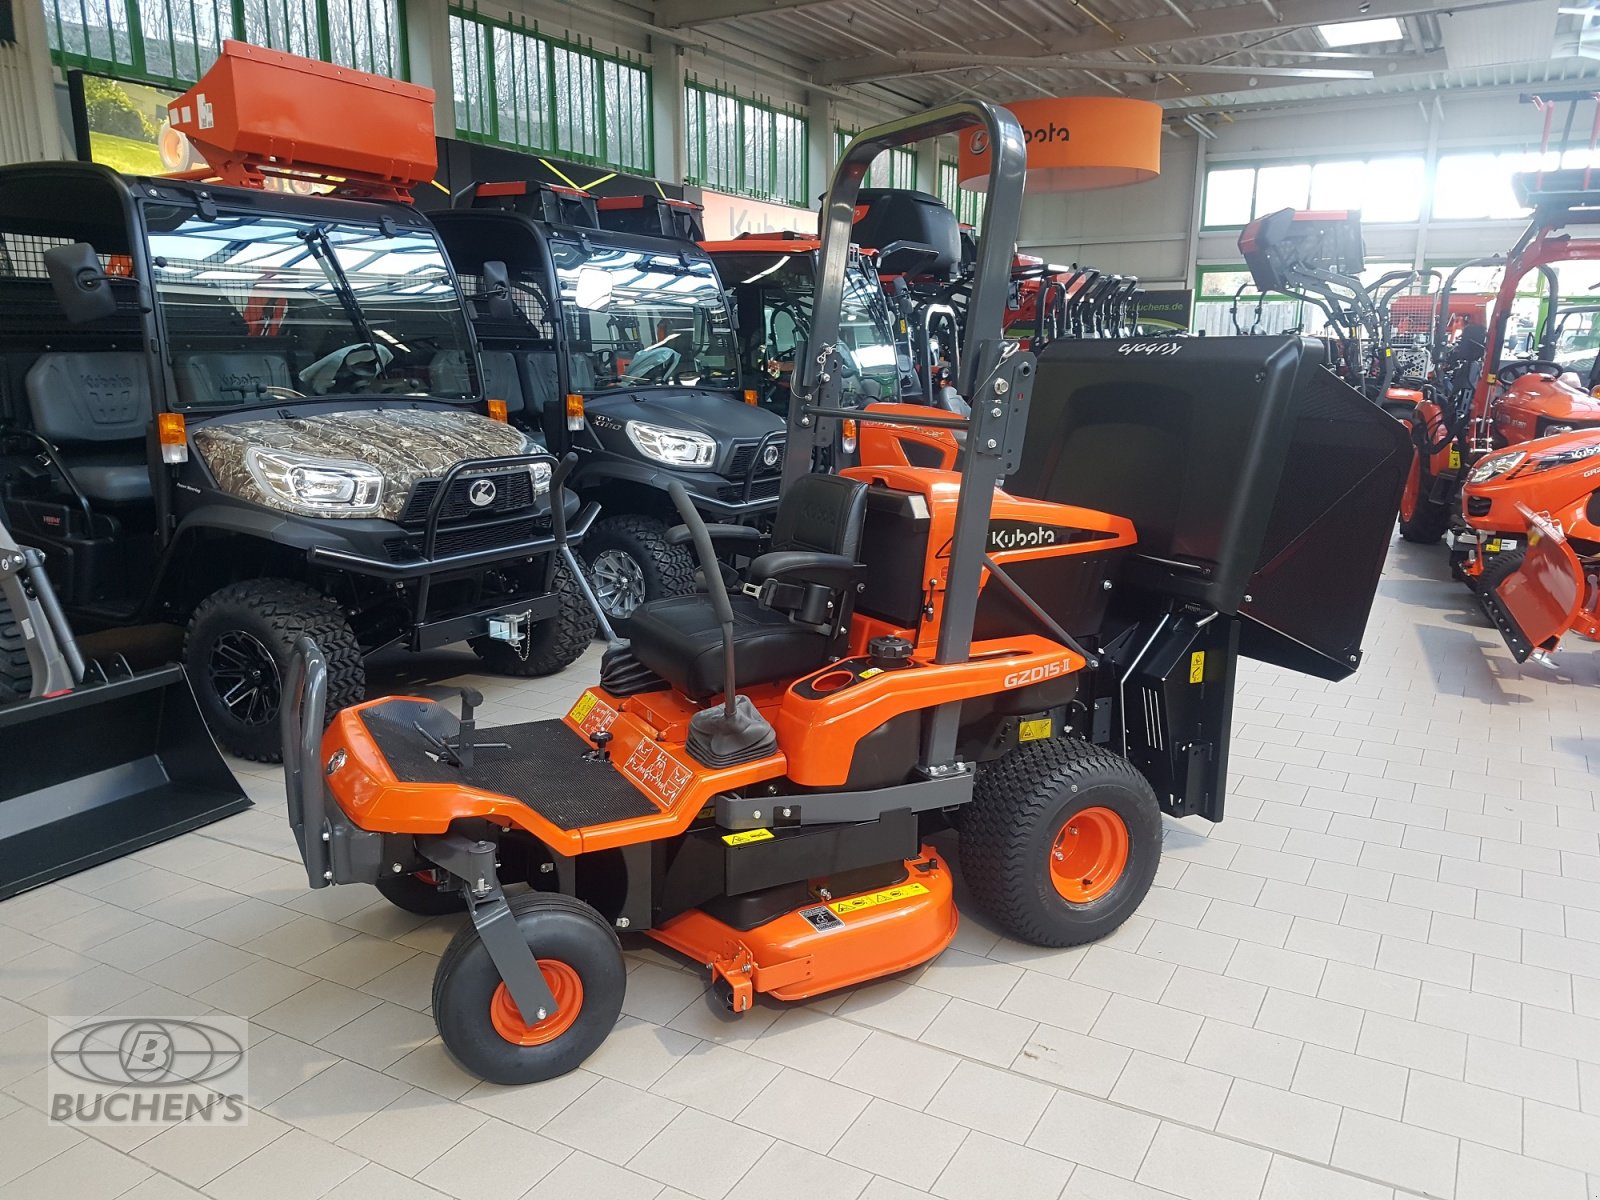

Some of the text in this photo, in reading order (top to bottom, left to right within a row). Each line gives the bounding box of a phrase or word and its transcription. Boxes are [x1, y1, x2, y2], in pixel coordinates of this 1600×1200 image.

[1020, 122, 1070, 144] bota
[729, 206, 809, 236] Kubt
[1118, 342, 1183, 356] Kubota
[992, 526, 1055, 548] Kubota
